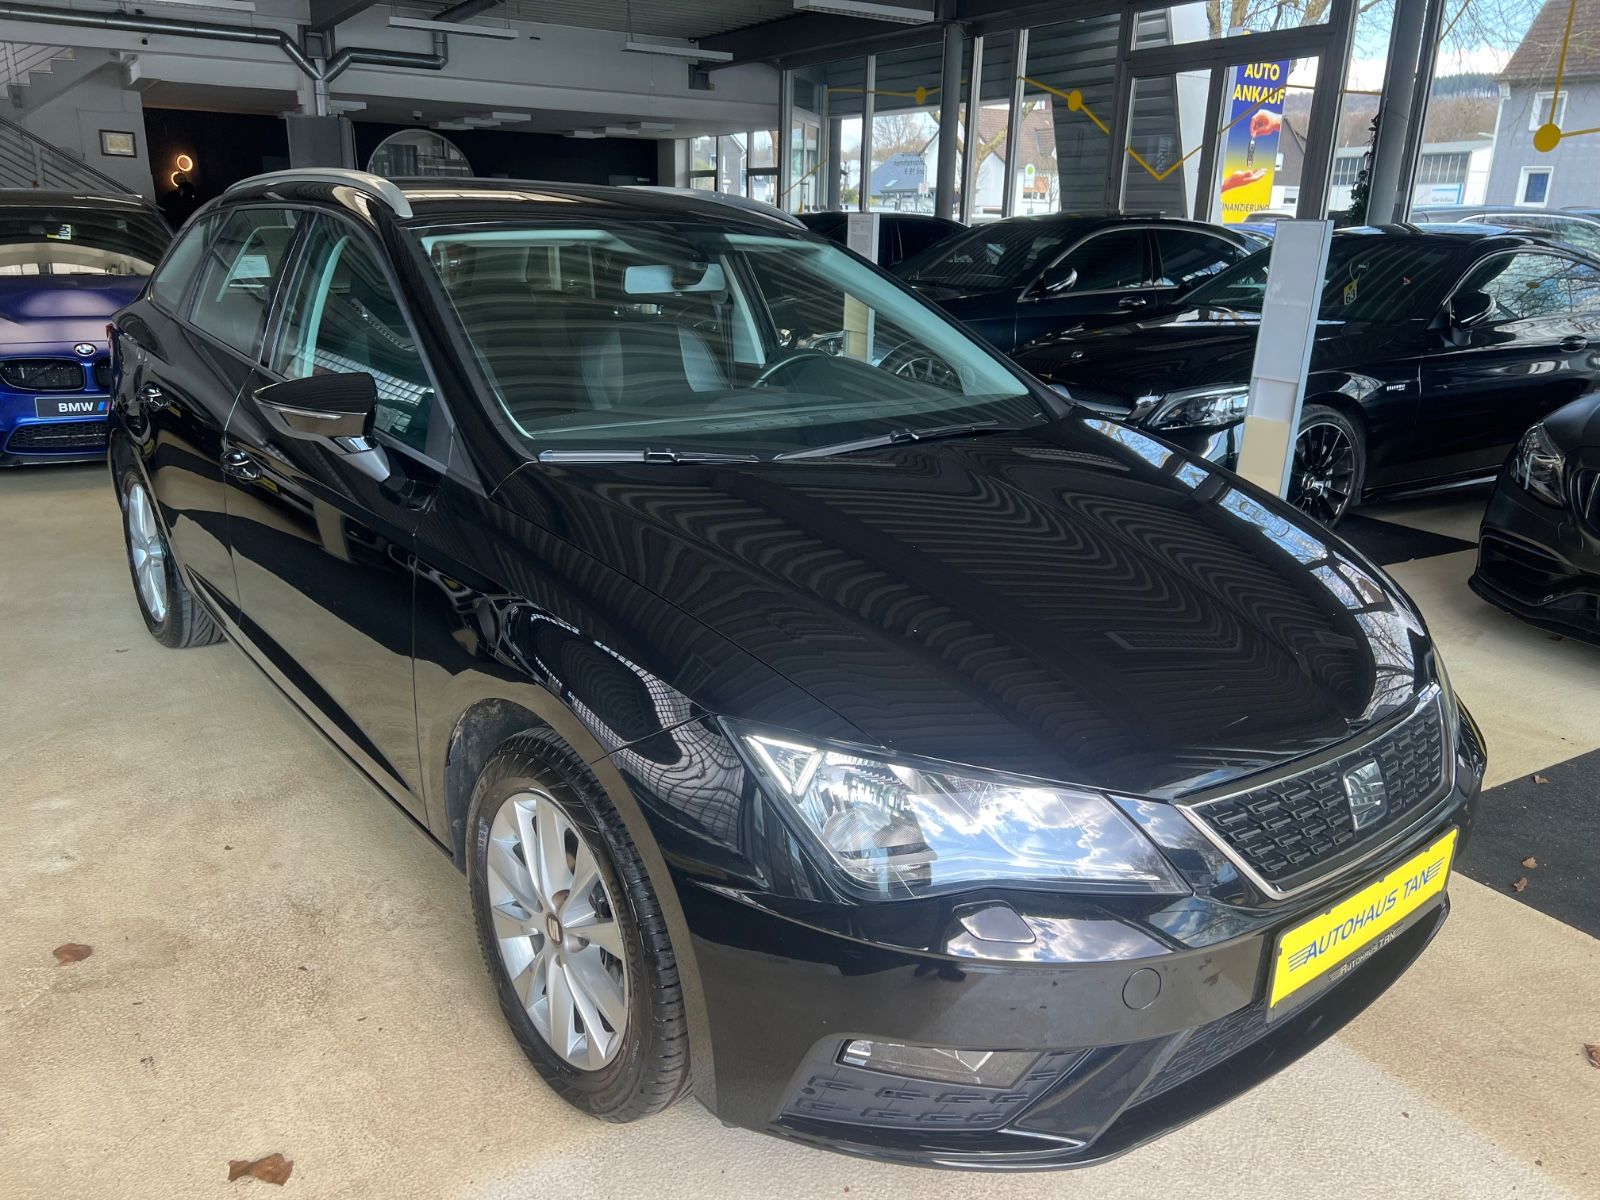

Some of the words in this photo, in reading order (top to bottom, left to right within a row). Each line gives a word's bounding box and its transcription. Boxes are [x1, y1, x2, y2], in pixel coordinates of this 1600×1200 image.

[1244, 62, 1280, 81] AUTO
[1232, 84, 1286, 104] ANKAUF
[1221, 202, 1270, 213] INANZIERUNG
[58, 402, 94, 413] BMW
[1304, 888, 1399, 964] AUTOHAUS
[1402, 866, 1433, 900] TAN
[1379, 931, 1395, 948] TAN
